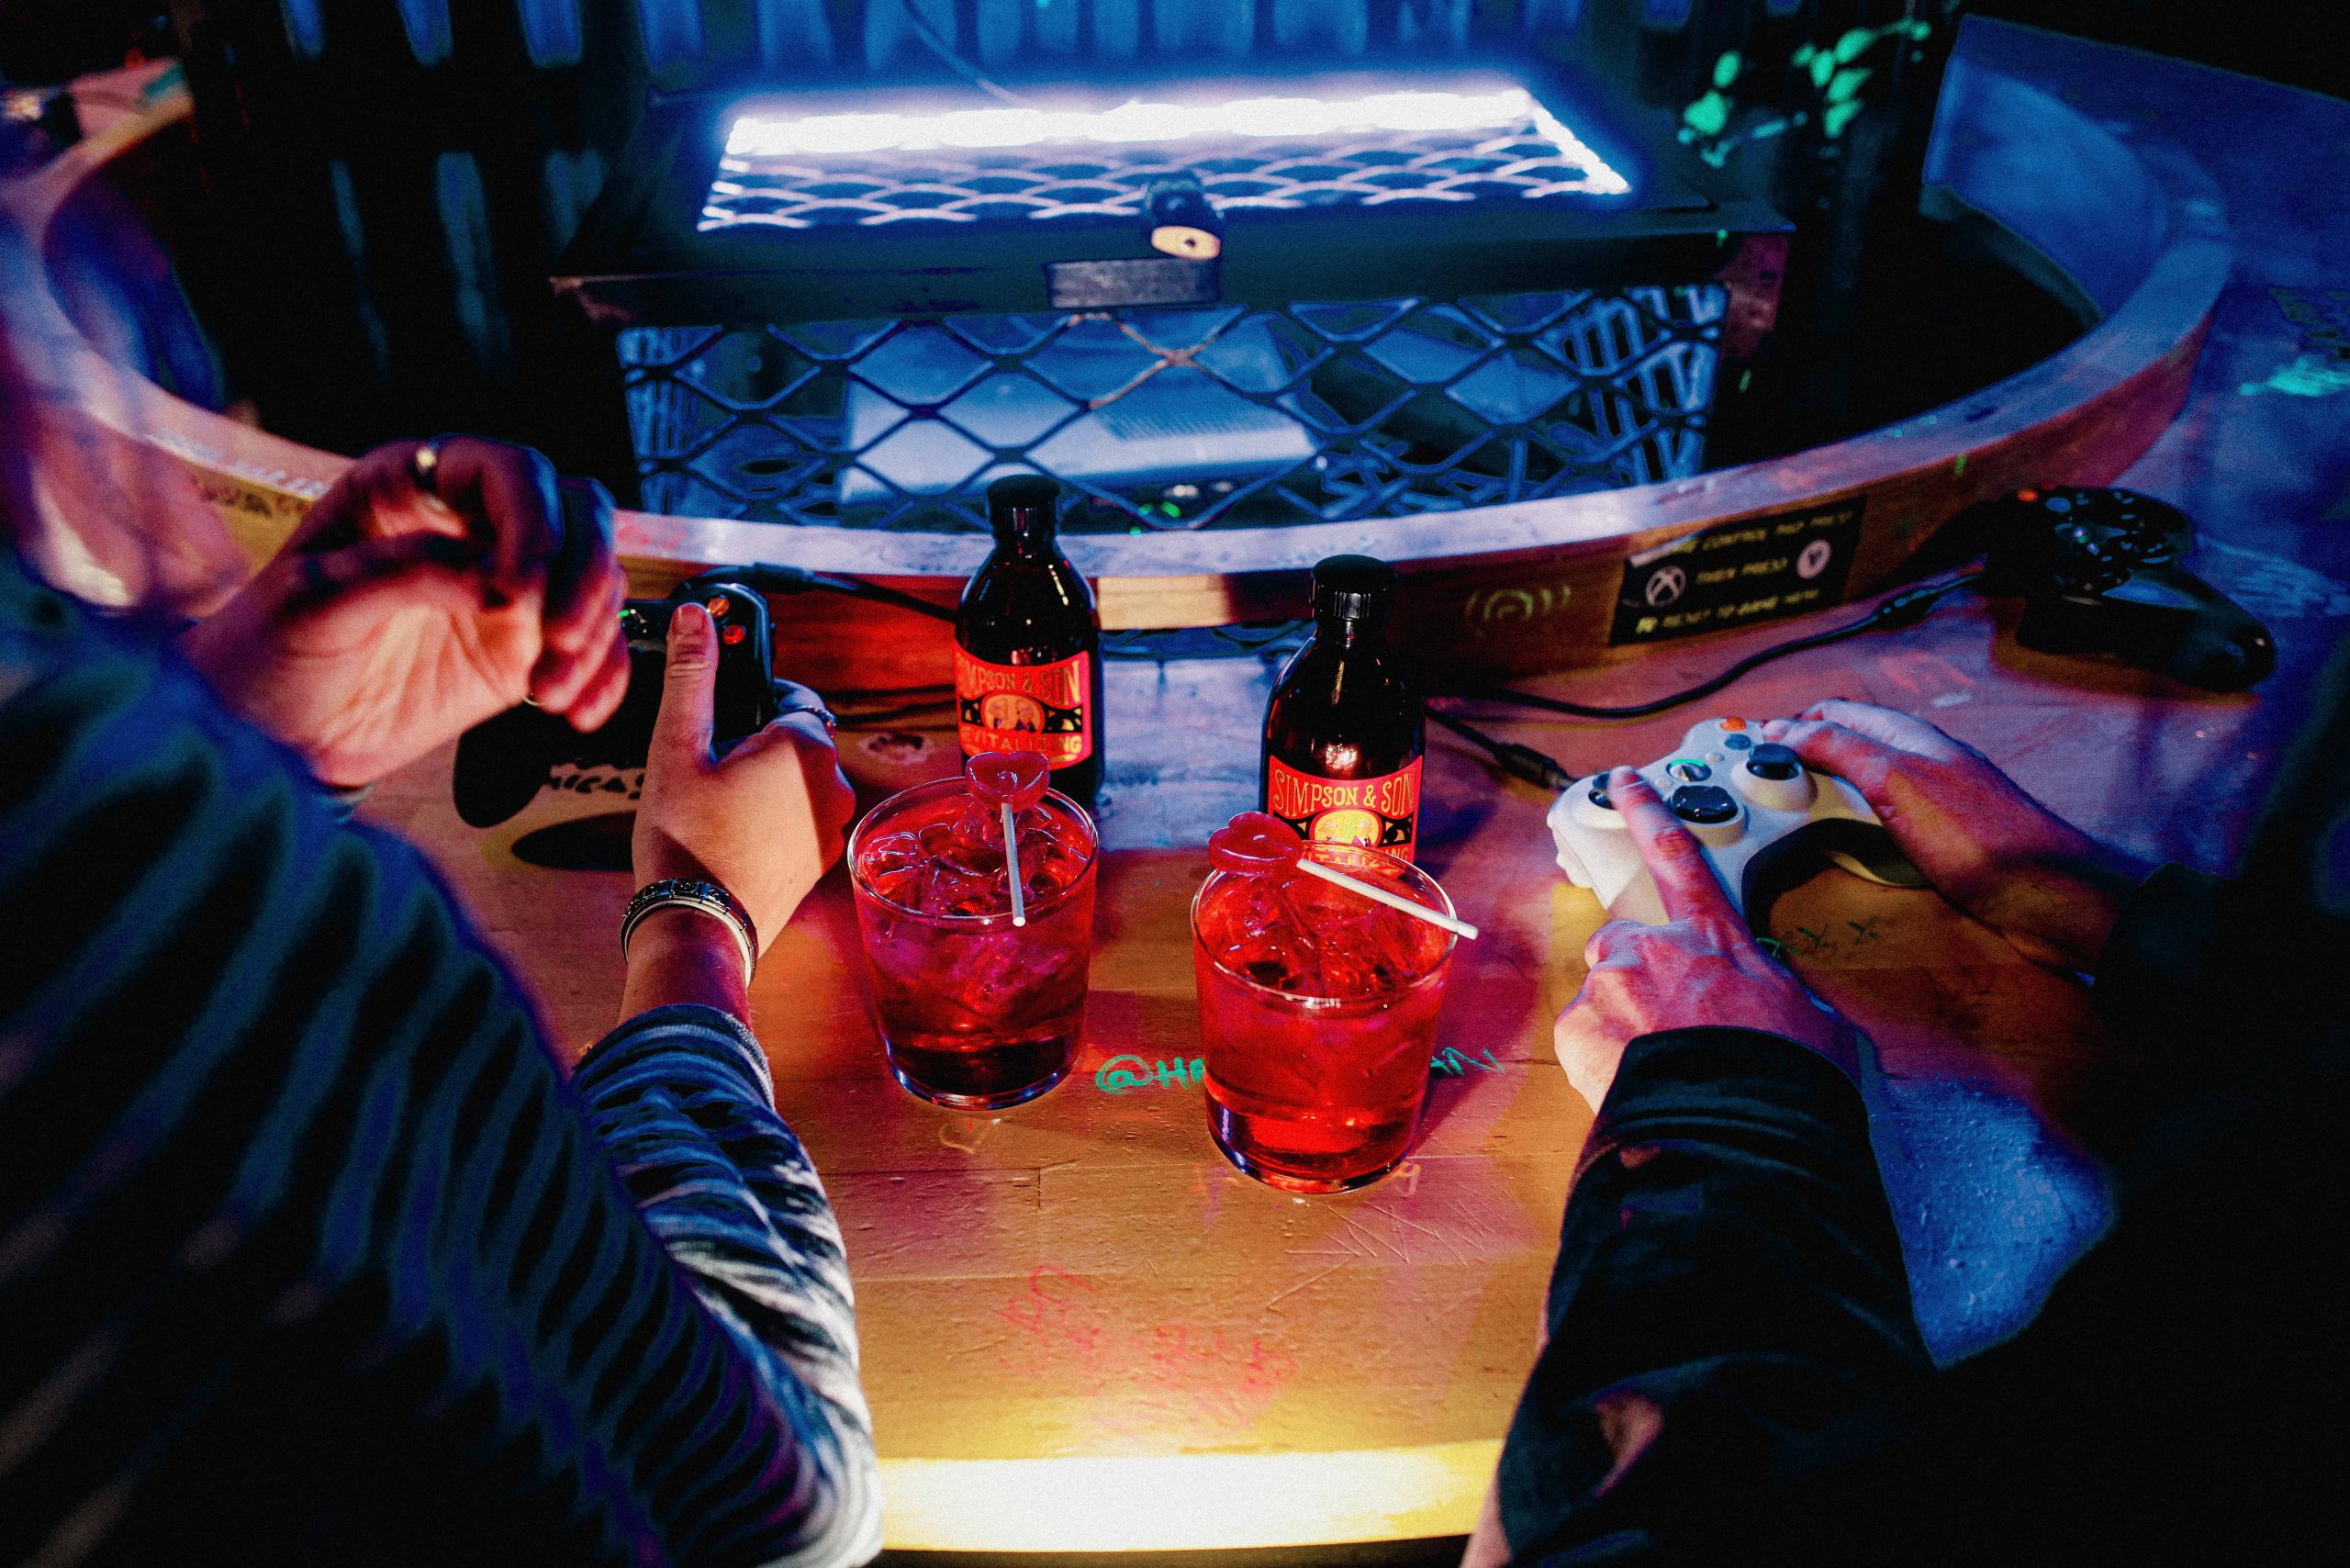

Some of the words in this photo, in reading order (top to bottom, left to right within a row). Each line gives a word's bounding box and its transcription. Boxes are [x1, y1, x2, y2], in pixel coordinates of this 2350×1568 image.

[1039, 660, 1081, 706] SON
[1273, 768, 1358, 818] SIMPSON
[1363, 784, 1377, 809] &
[1381, 769, 1415, 815] SON
